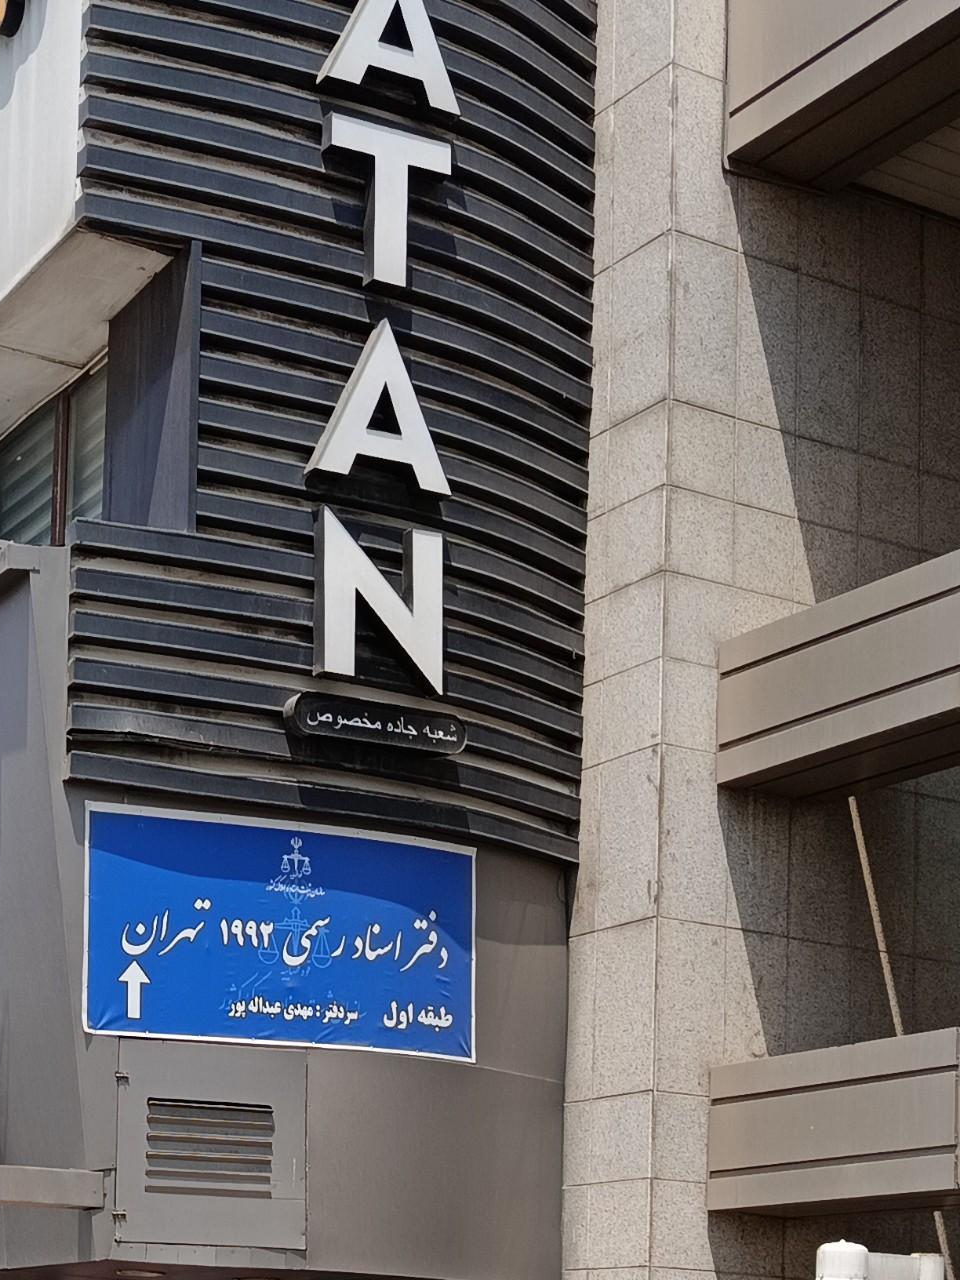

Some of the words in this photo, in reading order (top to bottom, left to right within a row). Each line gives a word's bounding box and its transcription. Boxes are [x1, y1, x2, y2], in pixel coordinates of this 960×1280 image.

[305, 711, 382, 731] مخصوص
[386, 715, 418, 740] جاده
[422, 723, 458, 744] شعبه
[120, 897, 213, 957] تهران
[219, 917, 275, 950] ۱۹۹۲
[281, 915, 346, 967] رسمی
[351, 922, 402, 962] اسناد
[399, 909, 449, 973] دفتر
[228, 999, 246, 1018] پور
[248, 996, 282, 1018] عبداله
[283, 1003, 314, 1020] مهدی
[382, 1000, 414, 1030] اول
[416, 1005, 454, 1032] طبقه
